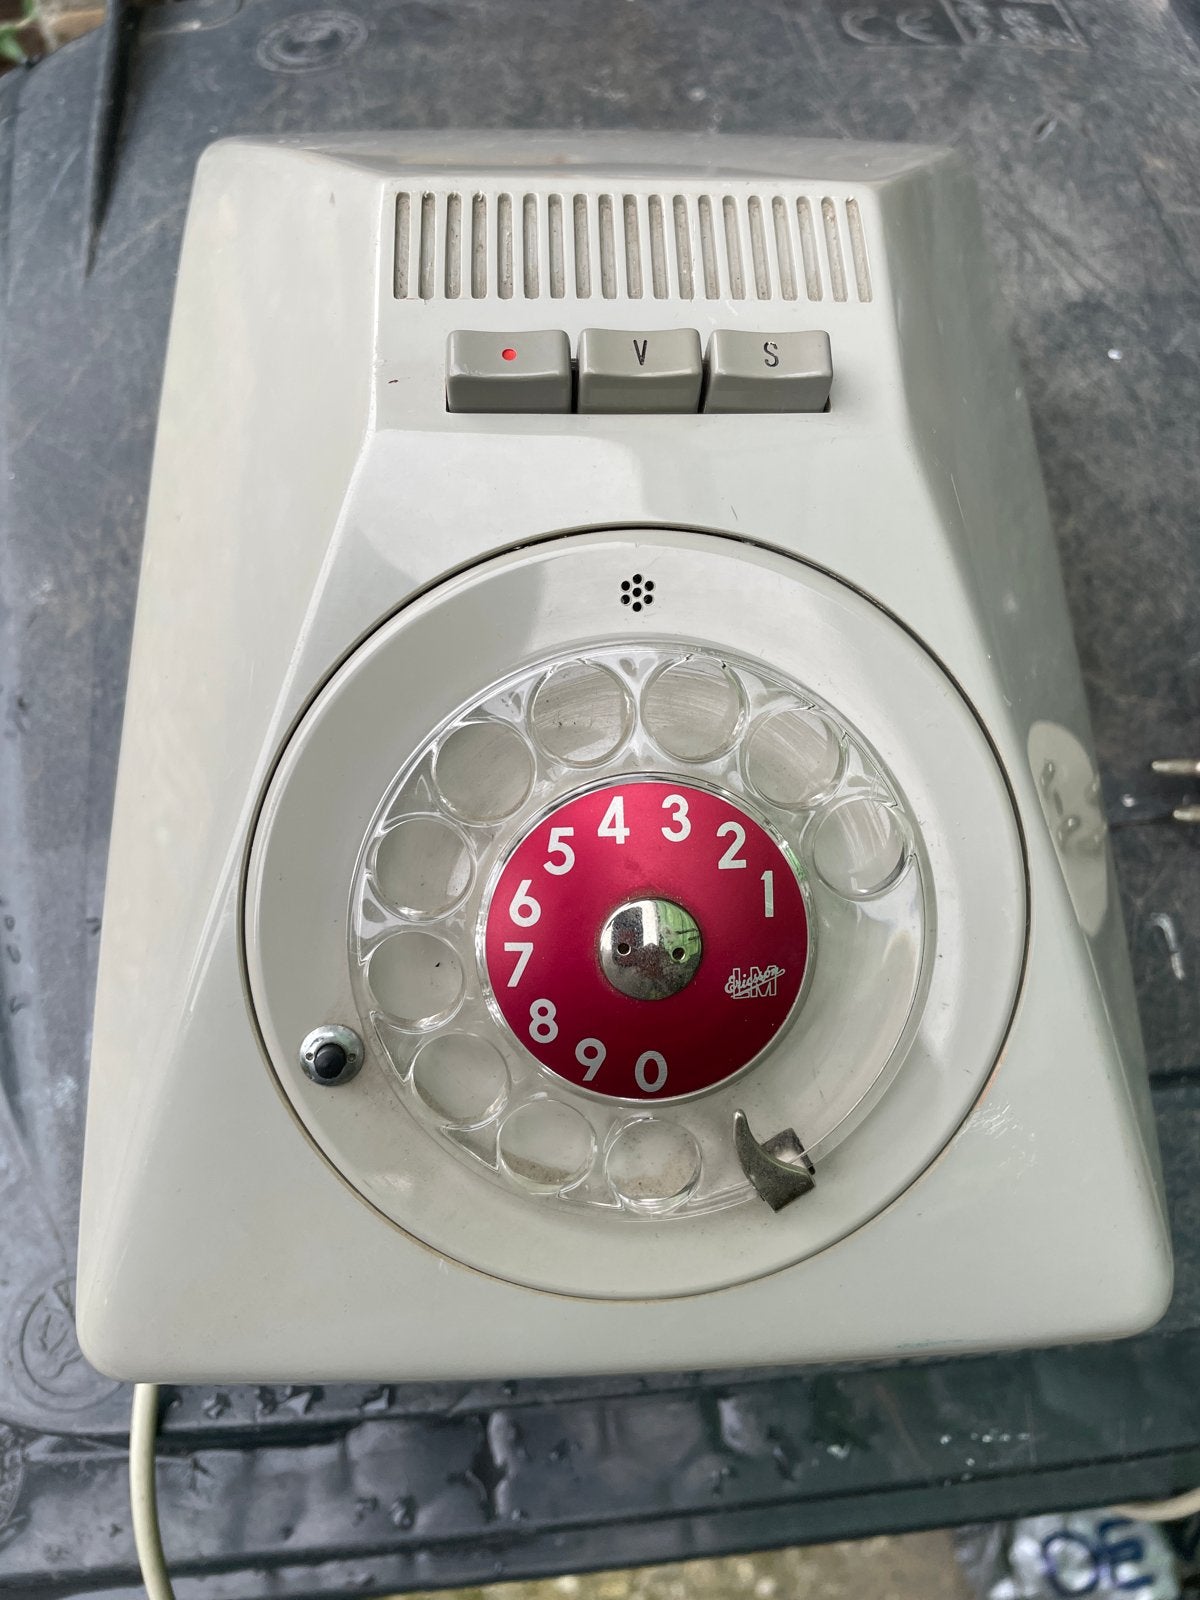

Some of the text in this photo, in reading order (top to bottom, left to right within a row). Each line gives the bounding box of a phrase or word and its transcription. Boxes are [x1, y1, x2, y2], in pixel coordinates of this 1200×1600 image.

[633, 339, 647, 366] V
[763, 341, 780, 368] S
[598, 796, 630, 844] 4
[661, 794, 691, 842] 3
[543, 827, 575, 875] 5
[716, 822, 747, 869] 2
[509, 879, 541, 927] 6
[760, 870, 774, 918] 1
[504, 942, 534, 987] 7
[529, 999, 559, 1043] 8
[575, 1038, 607, 1081] 9
[634, 1050, 668, 1092] 0
